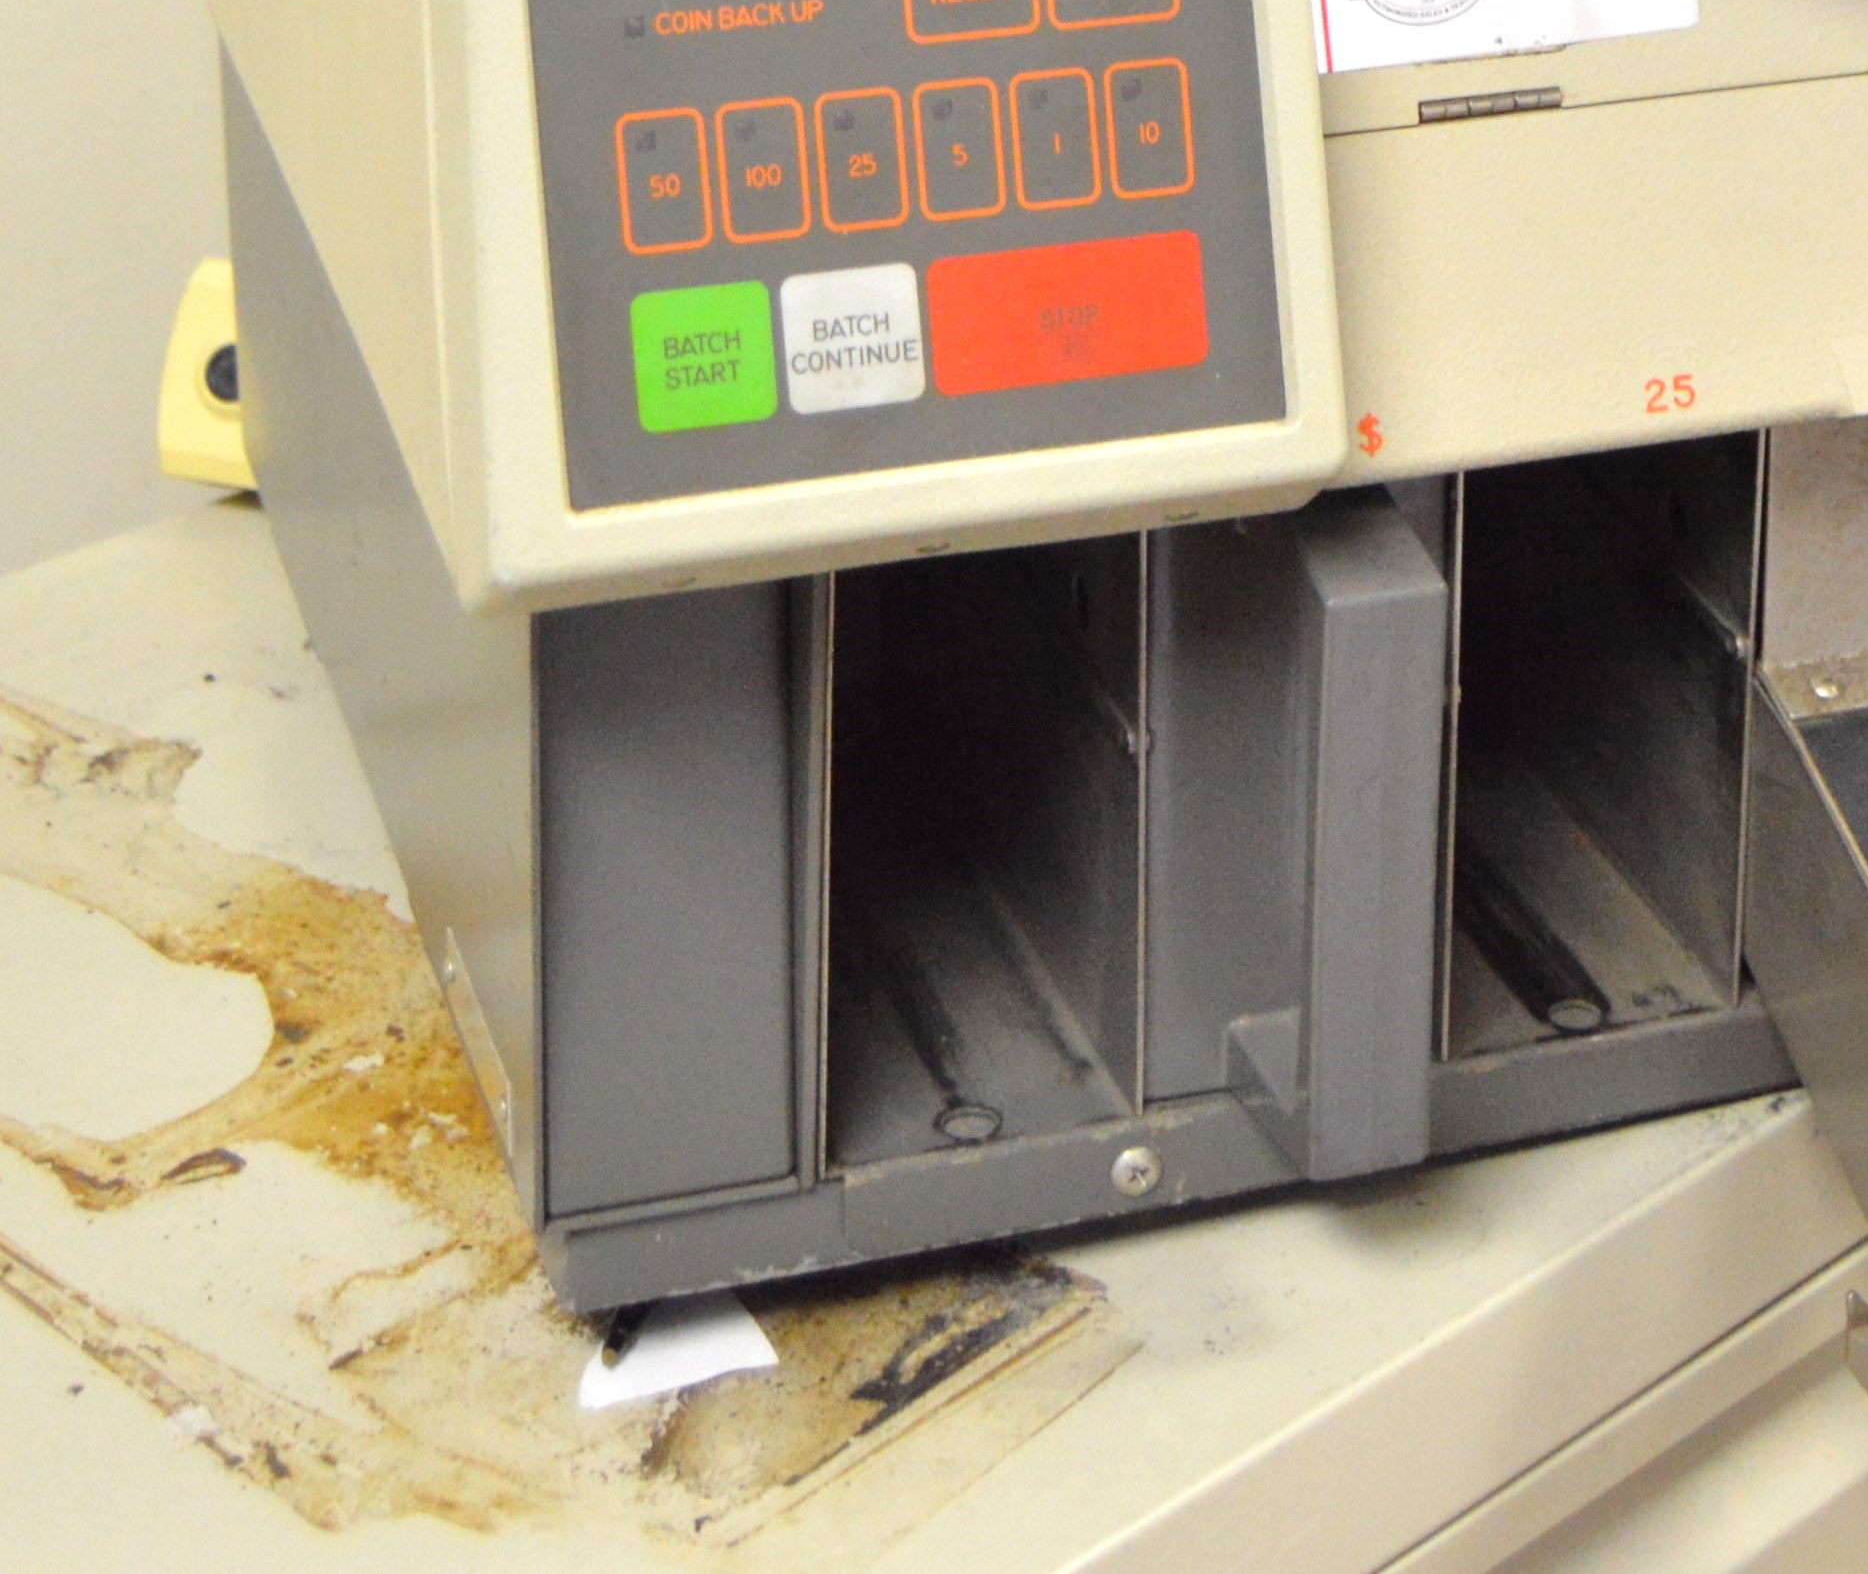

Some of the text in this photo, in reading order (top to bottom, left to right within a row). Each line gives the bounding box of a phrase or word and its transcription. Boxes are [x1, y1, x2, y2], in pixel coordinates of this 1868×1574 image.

[655, 0, 824, 36] COIN BACK UP
[1138, 121, 1160, 144] 10
[849, 154, 877, 177] 25
[952, 144, 968, 167] 5
[649, 174, 681, 198] 50
[745, 165, 782, 188] 100
[812, 312, 890, 342] BATCH
[1040, 303, 1100, 332] STOP
[663, 331, 741, 359] BATCH
[791, 340, 920, 375] CONTINUE
[665, 360, 741, 389] START
[1644, 372, 1697, 414] 25
[1357, 411, 1385, 459] $
